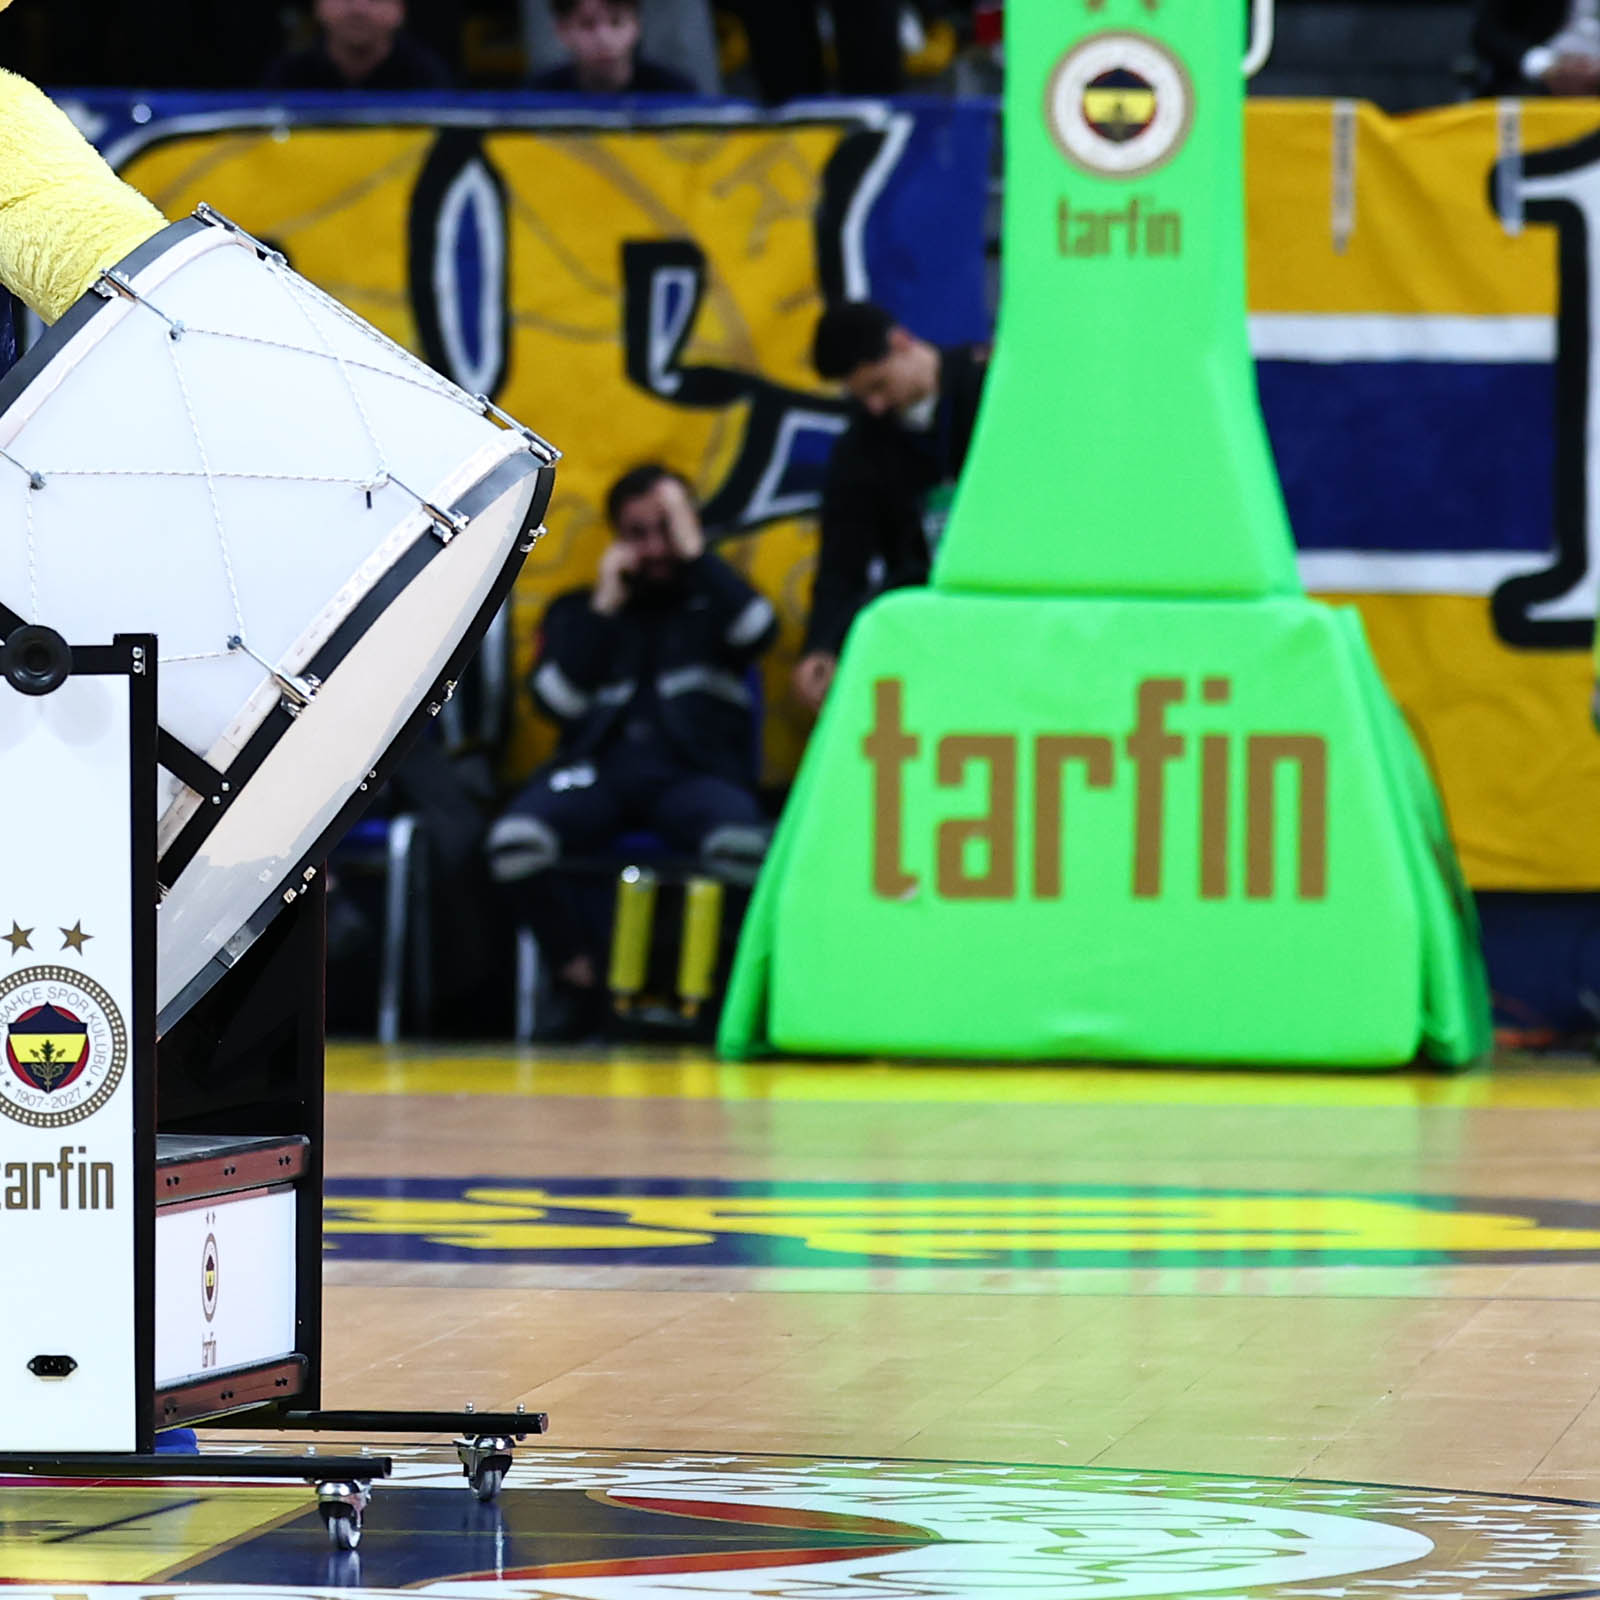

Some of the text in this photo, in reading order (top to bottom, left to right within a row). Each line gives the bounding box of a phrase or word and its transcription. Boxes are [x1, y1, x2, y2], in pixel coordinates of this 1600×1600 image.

[1055, 195, 1182, 260] tarfin
[862, 676, 1328, 901] tarfin
[46, 986, 90, 1014] SPOR
[86, 1012, 107, 1077] KULÜBÜ
[14, 1087, 83, 1109] 1907-2027
